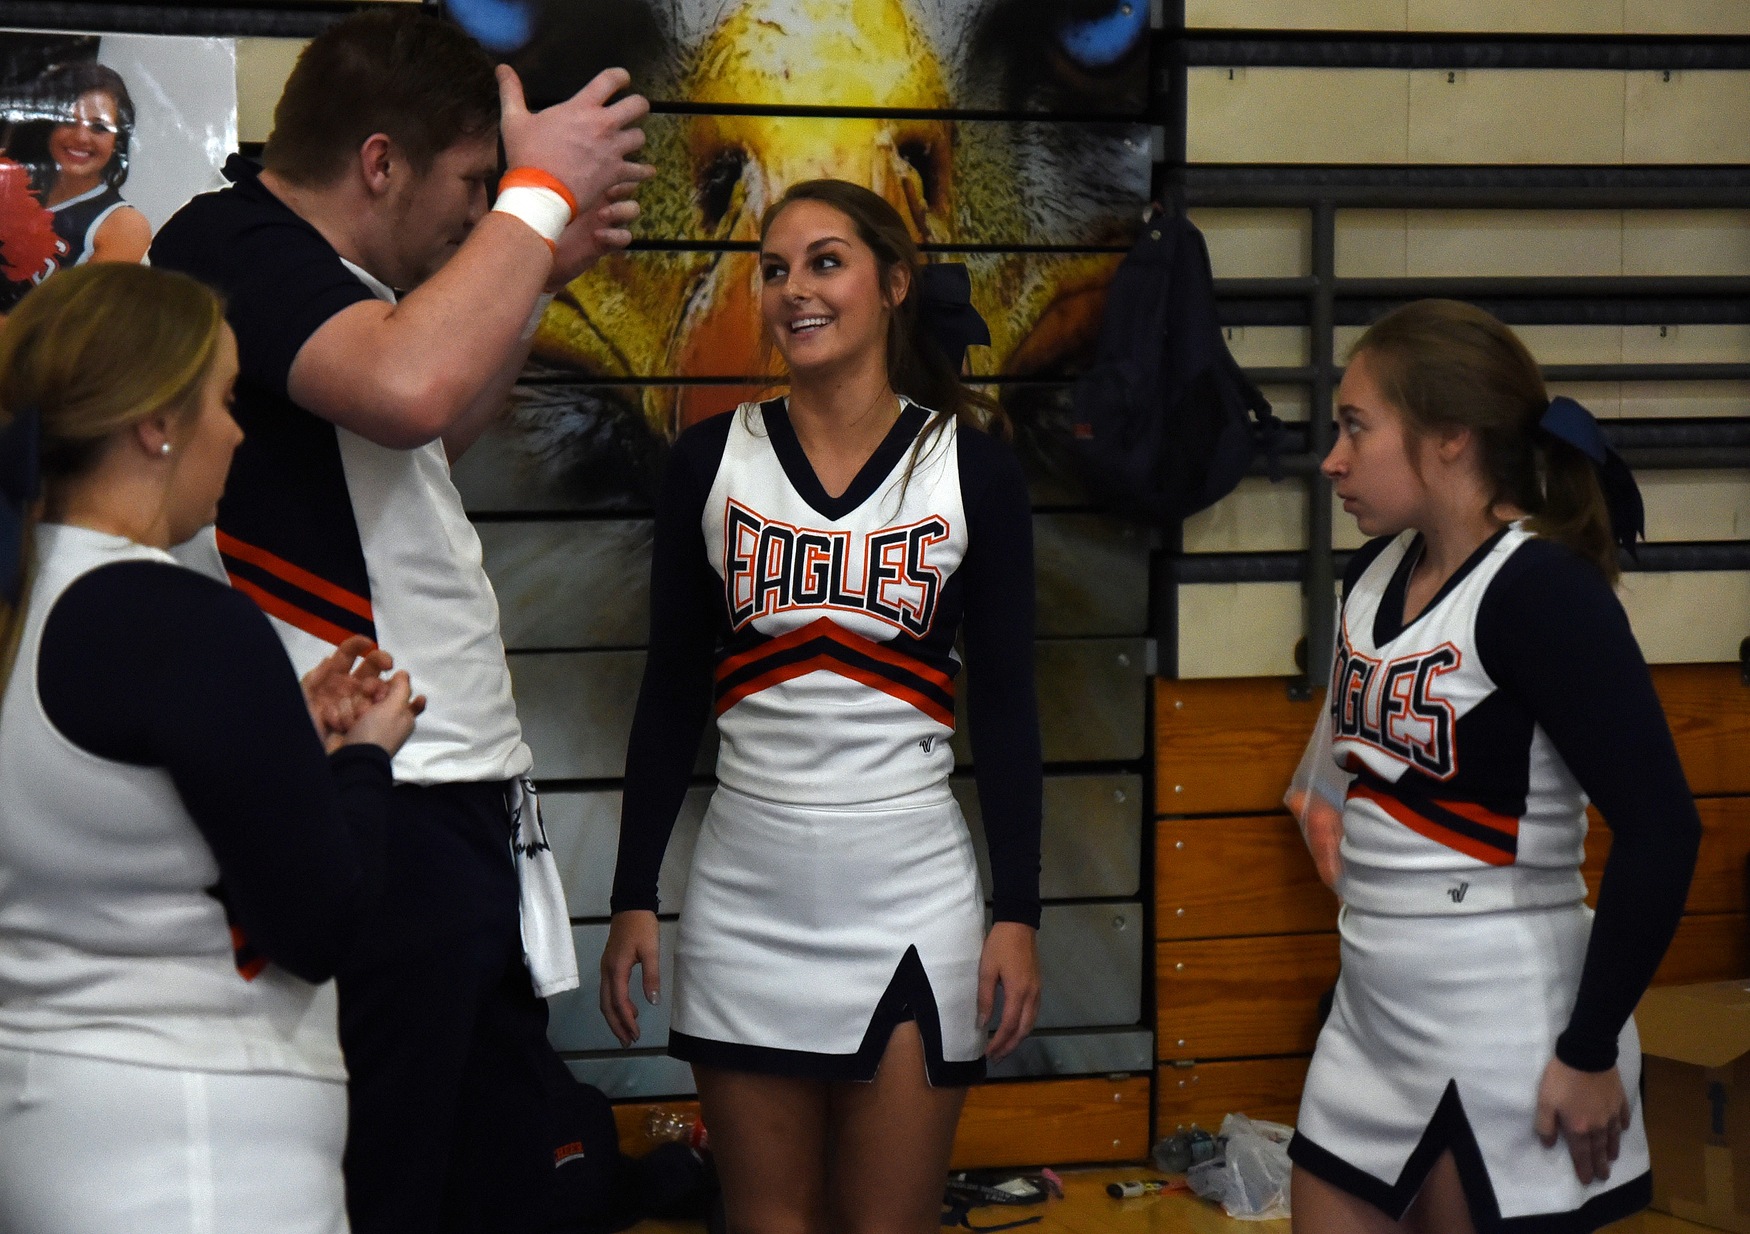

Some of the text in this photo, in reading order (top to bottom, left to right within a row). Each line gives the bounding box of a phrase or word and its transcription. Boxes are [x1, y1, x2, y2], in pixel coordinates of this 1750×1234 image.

[1228, 69, 1234, 81] 1
[1447, 71, 1455, 84] 2
[1663, 70, 1670, 83] 3
[1660, 326, 1667, 338] 3
[724, 497, 950, 640] EAGLES
[1332, 614, 1461, 782] AGLES
